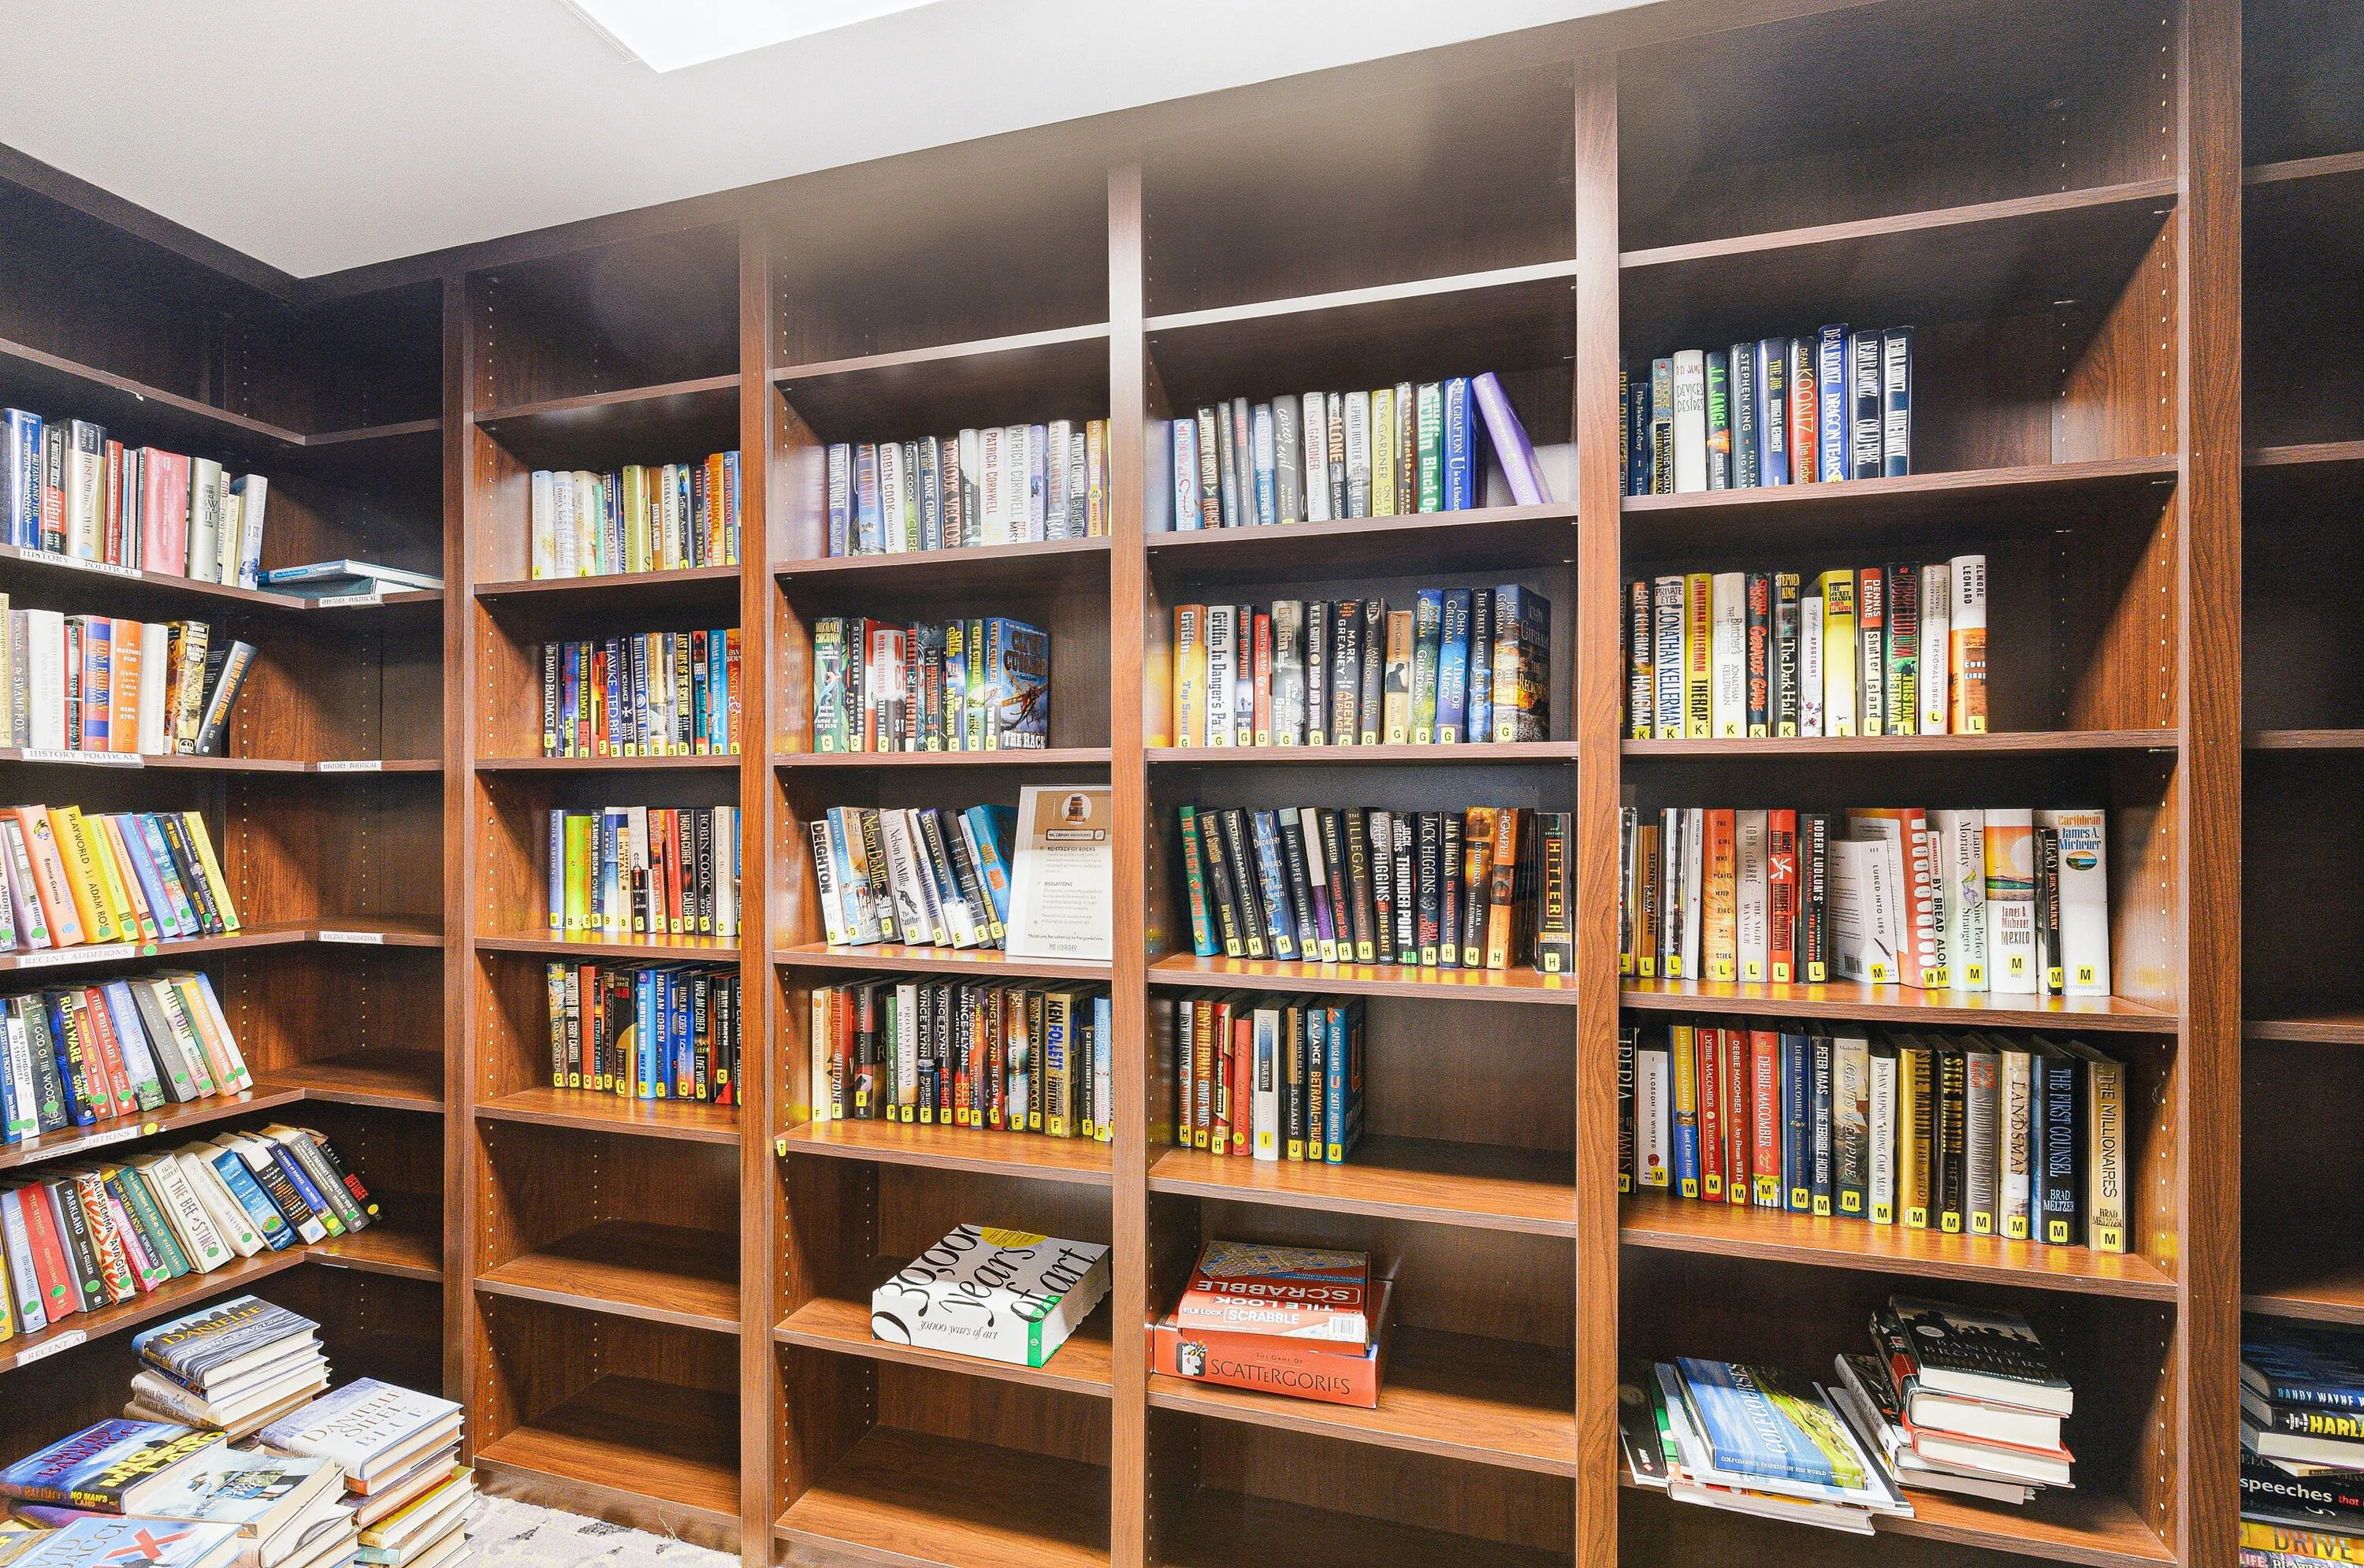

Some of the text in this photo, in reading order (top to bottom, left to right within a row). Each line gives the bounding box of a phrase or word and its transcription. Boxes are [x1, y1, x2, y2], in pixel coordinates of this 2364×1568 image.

[1825, 329, 1841, 349] DEAN
[1741, 353, 1751, 431] STEPHEN KING
[1770, 359, 1782, 390] THE JOB
[1794, 368, 1813, 434] KOONTZ
[1826, 392, 1841, 440] DRAGON
[1309, 428, 1320, 470] GARDNER
[1329, 417, 1344, 463] ALONE
[1378, 425, 1387, 479] GARDNER
[1857, 419, 1879, 465] COLD FIRE
[883, 448, 895, 511] ROBIN COOK
[924, 475, 935, 498] DIANE
[986, 433, 997, 515] PATRICIA CORNWELL
[1010, 427, 1023, 517] PATRICIA CORNWELL
[1422, 456, 1437, 490] Black
[23, 549, 69, 563] HISTORY
[1656, 587, 1682, 596] PRIVATE
[1864, 580, 1873, 618] LEHANE
[1872, 580, 1881, 617] DENNIS
[1963, 565, 1972, 604] LEONARD
[1444, 600, 1456, 644] GRISHAM
[1457, 610, 1467, 634] JOHN
[1477, 592, 1487, 664] THE LAWYER
[1507, 601, 1515, 625] JOHN
[677, 634, 687, 648] LAST
[678, 650, 687, 664] DAYS
[1336, 619, 1346, 674] GREANEY
[1346, 630, 1355, 663] MARK
[1659, 610, 1680, 664] JONATHAN
[606, 643, 618, 717] HAWKE TED
[1209, 611, 1228, 708] Griffin In Danger's
[1414, 650, 1427, 705] GUARDIANS
[1868, 634, 1880, 718] Shutter Island
[545, 656, 556, 727] DAVID BALDACCI
[579, 682, 589, 719] BALDACCI
[678, 675, 687, 686] THE
[1781, 663, 1796, 715] Dark Half
[1344, 692, 1354, 734] AGENT
[30, 750, 135, 761] HISTORY POLITICAL
[1005, 731, 1021, 748] THE
[680, 815, 691, 839] HARLAN
[1957, 821, 1971, 866] Moriarty
[1972, 829, 1981, 859] Liane
[44, 857, 54, 881] Bonnie
[69, 813, 102, 911] PLAYWORLD ADAM
[700, 814, 710, 890] ROBIN COOK
[814, 823, 832, 894] DEIGHTON
[862, 815, 883, 890] Nelson DeMille
[1350, 821, 1364, 882] ILLEGAL
[1422, 816, 1437, 894] JACK HIGGINS
[1813, 819, 1824, 905] ROBERT LUDLUM'S
[1373, 851, 1389, 901] HIGGINS
[1548, 842, 1563, 915] HITLER
[1933, 878, 1941, 894] BY
[1396, 856, 1412, 946] THUNDER POINT
[1934, 897, 1944, 933] BREAD
[25, 948, 129, 964] RECENT ADDITIONS
[1936, 938, 1946, 968] ALON
[164, 990, 180, 1011] THE
[695, 980, 705, 1033] HARLAN COBEN
[34, 1027, 46, 1046] GOD
[59, 996, 83, 1063] RUTH WARE
[173, 1013, 193, 1040] FURY
[1048, 1001, 1064, 1070] KEN FOLLETT
[1197, 1005, 1210, 1077] TONY HILLERMAN
[1311, 1072, 1321, 1116] BETRAYAL
[1816, 1046, 1828, 1184] PETER MAAS THE HOURS
[2050, 1069, 2072, 1177] THE FIRST COUNSEL
[2099, 1073, 2117, 1198] THE MILLIONAIRES
[65, 1189, 84, 1235] PARKLAND
[170, 1179, 198, 1220] THE BEE
[2043, 1200, 2074, 1212] MELTZER
[2050, 1189, 2070, 1200] BRAD
[2099, 1209, 2118, 1219] BRAD
[2054, 1225, 2064, 1236] M
[2105, 1233, 2116, 1245] M
[939, 1247, 1035, 1328] years
[1039, 1247, 1097, 1294] art
[1196, 1280, 1349, 1300] SCRABBLE
[1006, 1281, 1049, 1322] of
[1228, 1308, 1299, 1325] SCRABBLE
[1285, 1302, 1335, 1312] TILE
[162, 1305, 265, 1345] DANIELLE
[948, 1325, 998, 1339] years of art
[28, 1341, 69, 1360] RECENT
[1210, 1358, 1350, 1395] SCATTERGORIES
[303, 1392, 407, 1442] DANIELLE
[2316, 1391, 2354, 1406] WAYNE
[340, 1405, 407, 1437] STEEL
[355, 1406, 429, 1447] BLUE
[70, 1491, 108, 1503] NO MAN'S
[2239, 1477, 2332, 1503] speeches
[2338, 1495, 2359, 1507] that
[2273, 1525, 2353, 1561] DRIVE
